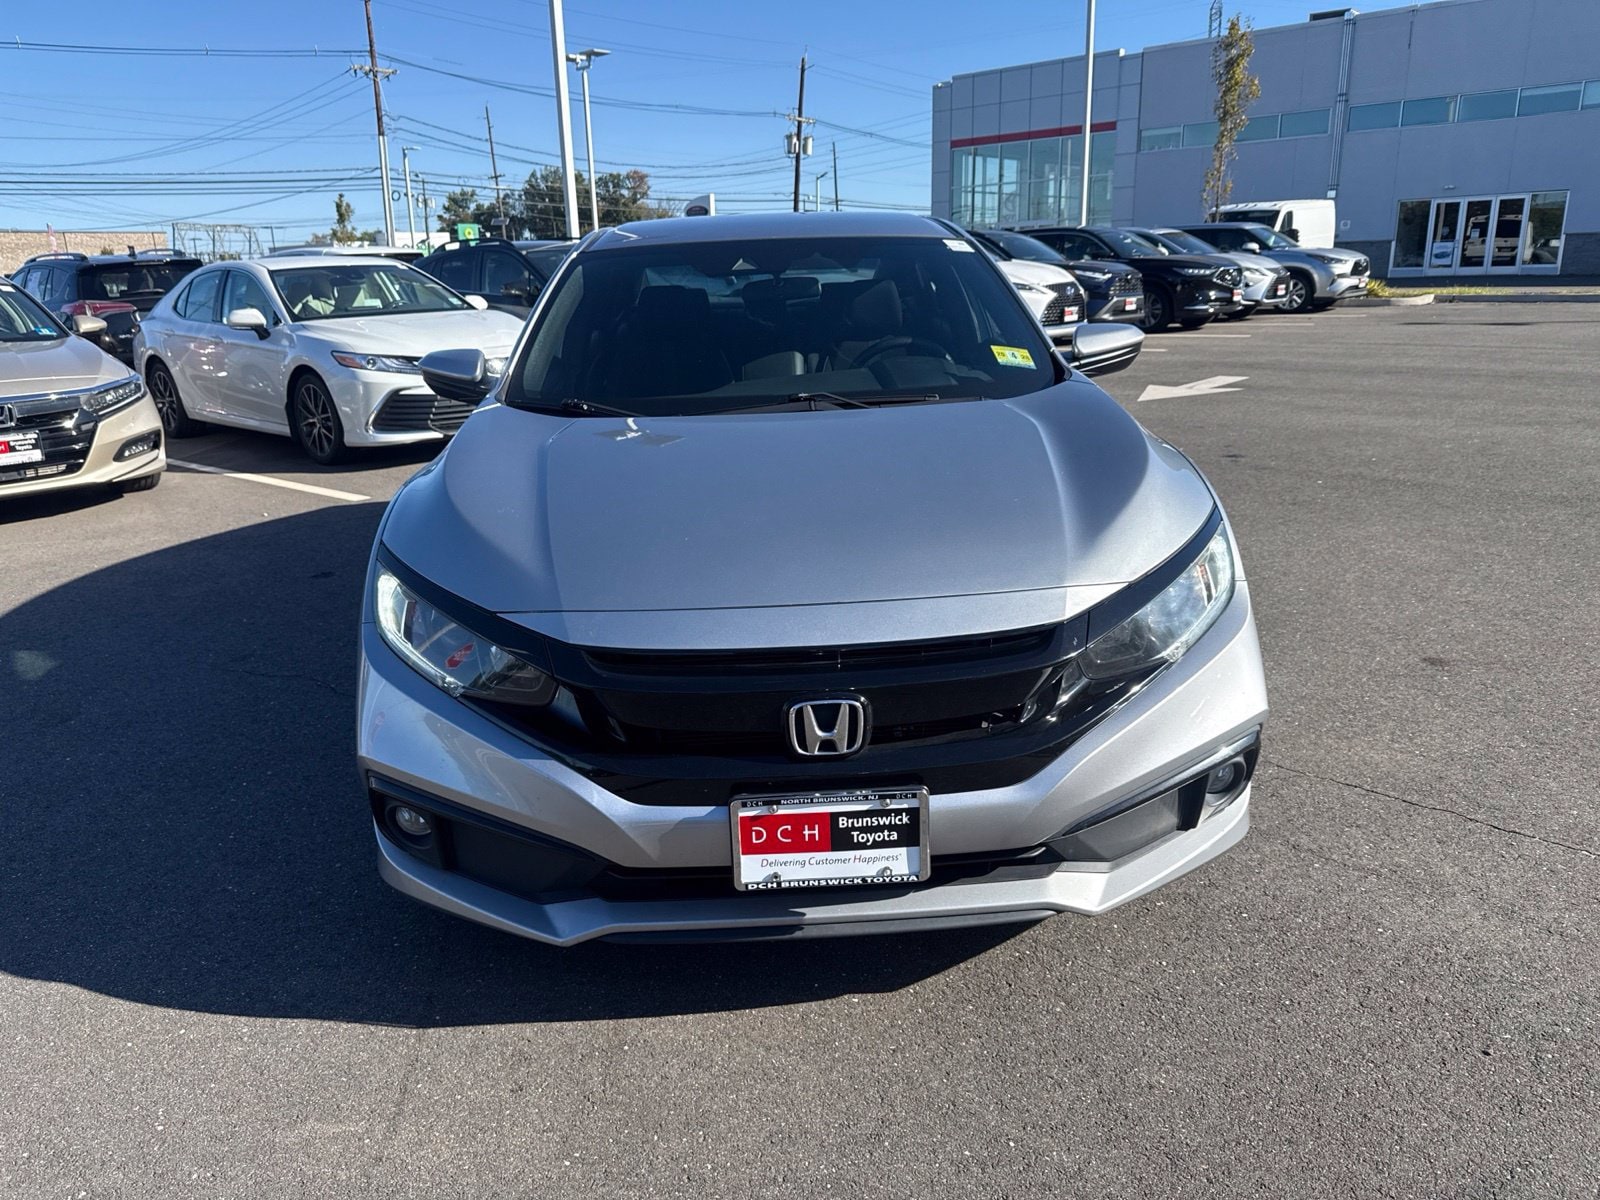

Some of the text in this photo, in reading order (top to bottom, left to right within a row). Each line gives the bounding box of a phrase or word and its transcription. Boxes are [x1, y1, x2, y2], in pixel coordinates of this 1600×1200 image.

[838, 811, 911, 829] Brunswick
[851, 829, 898, 846] Toyota
[760, 858, 806, 868] Delivering
[808, 856, 852, 865] Customer
[748, 875, 918, 890] DCH BRUNSWICK TOYOTA
